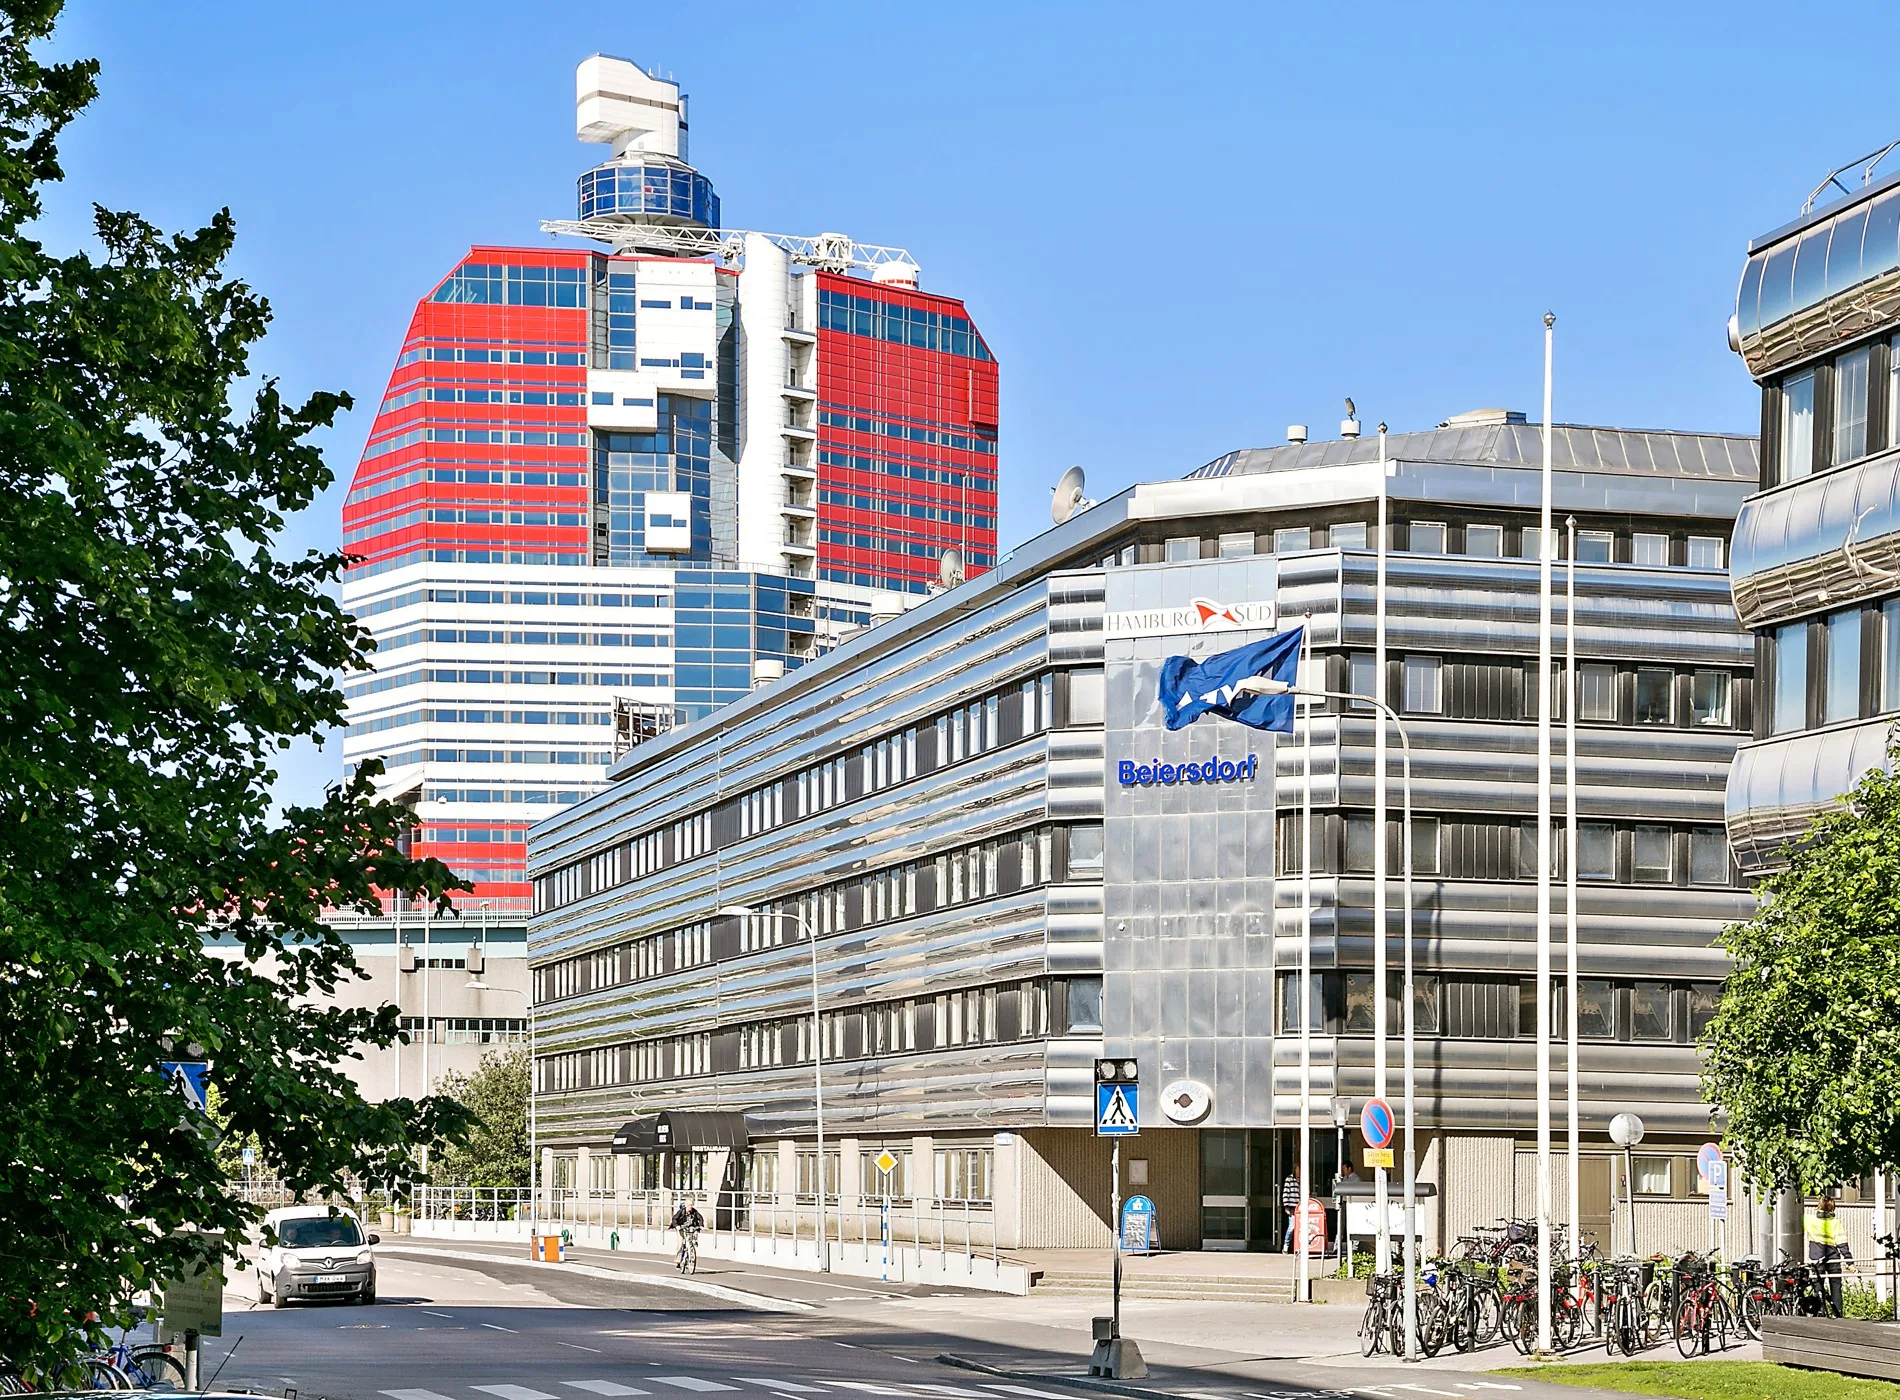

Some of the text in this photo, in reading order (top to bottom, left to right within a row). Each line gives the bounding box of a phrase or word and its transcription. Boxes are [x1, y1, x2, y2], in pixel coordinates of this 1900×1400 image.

[1108, 604, 1272, 632] HAMBURG SÜD
[1118, 754, 1256, 785] Beiersdorf
[1713, 1164, 1722, 1184] P
